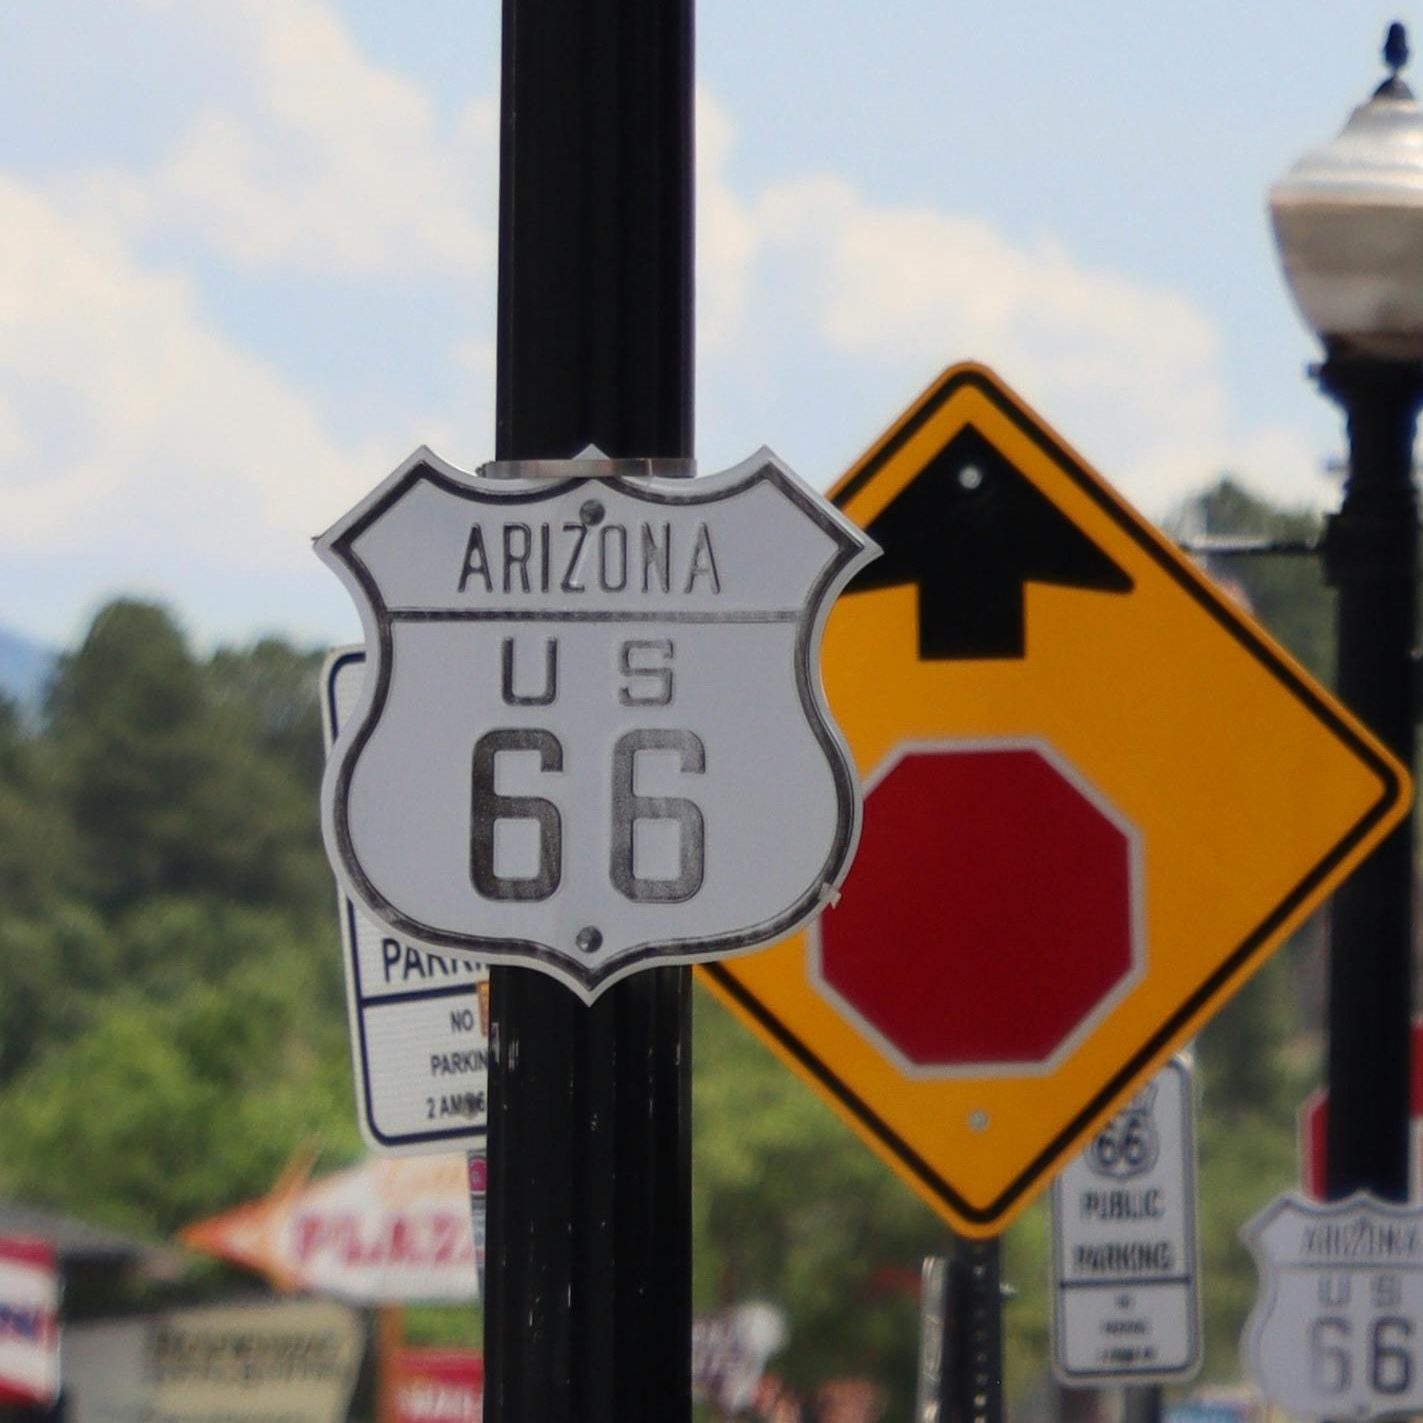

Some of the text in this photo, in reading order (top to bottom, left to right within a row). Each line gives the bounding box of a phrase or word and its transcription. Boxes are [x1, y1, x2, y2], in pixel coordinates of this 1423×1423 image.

[458, 522, 721, 595] ARIZONA
[468, 727, 707, 904] 66
[451, 1009, 474, 1033] NO
[1095, 1114, 1145, 1167] 66
[1309, 1315, 1414, 1395] 66
